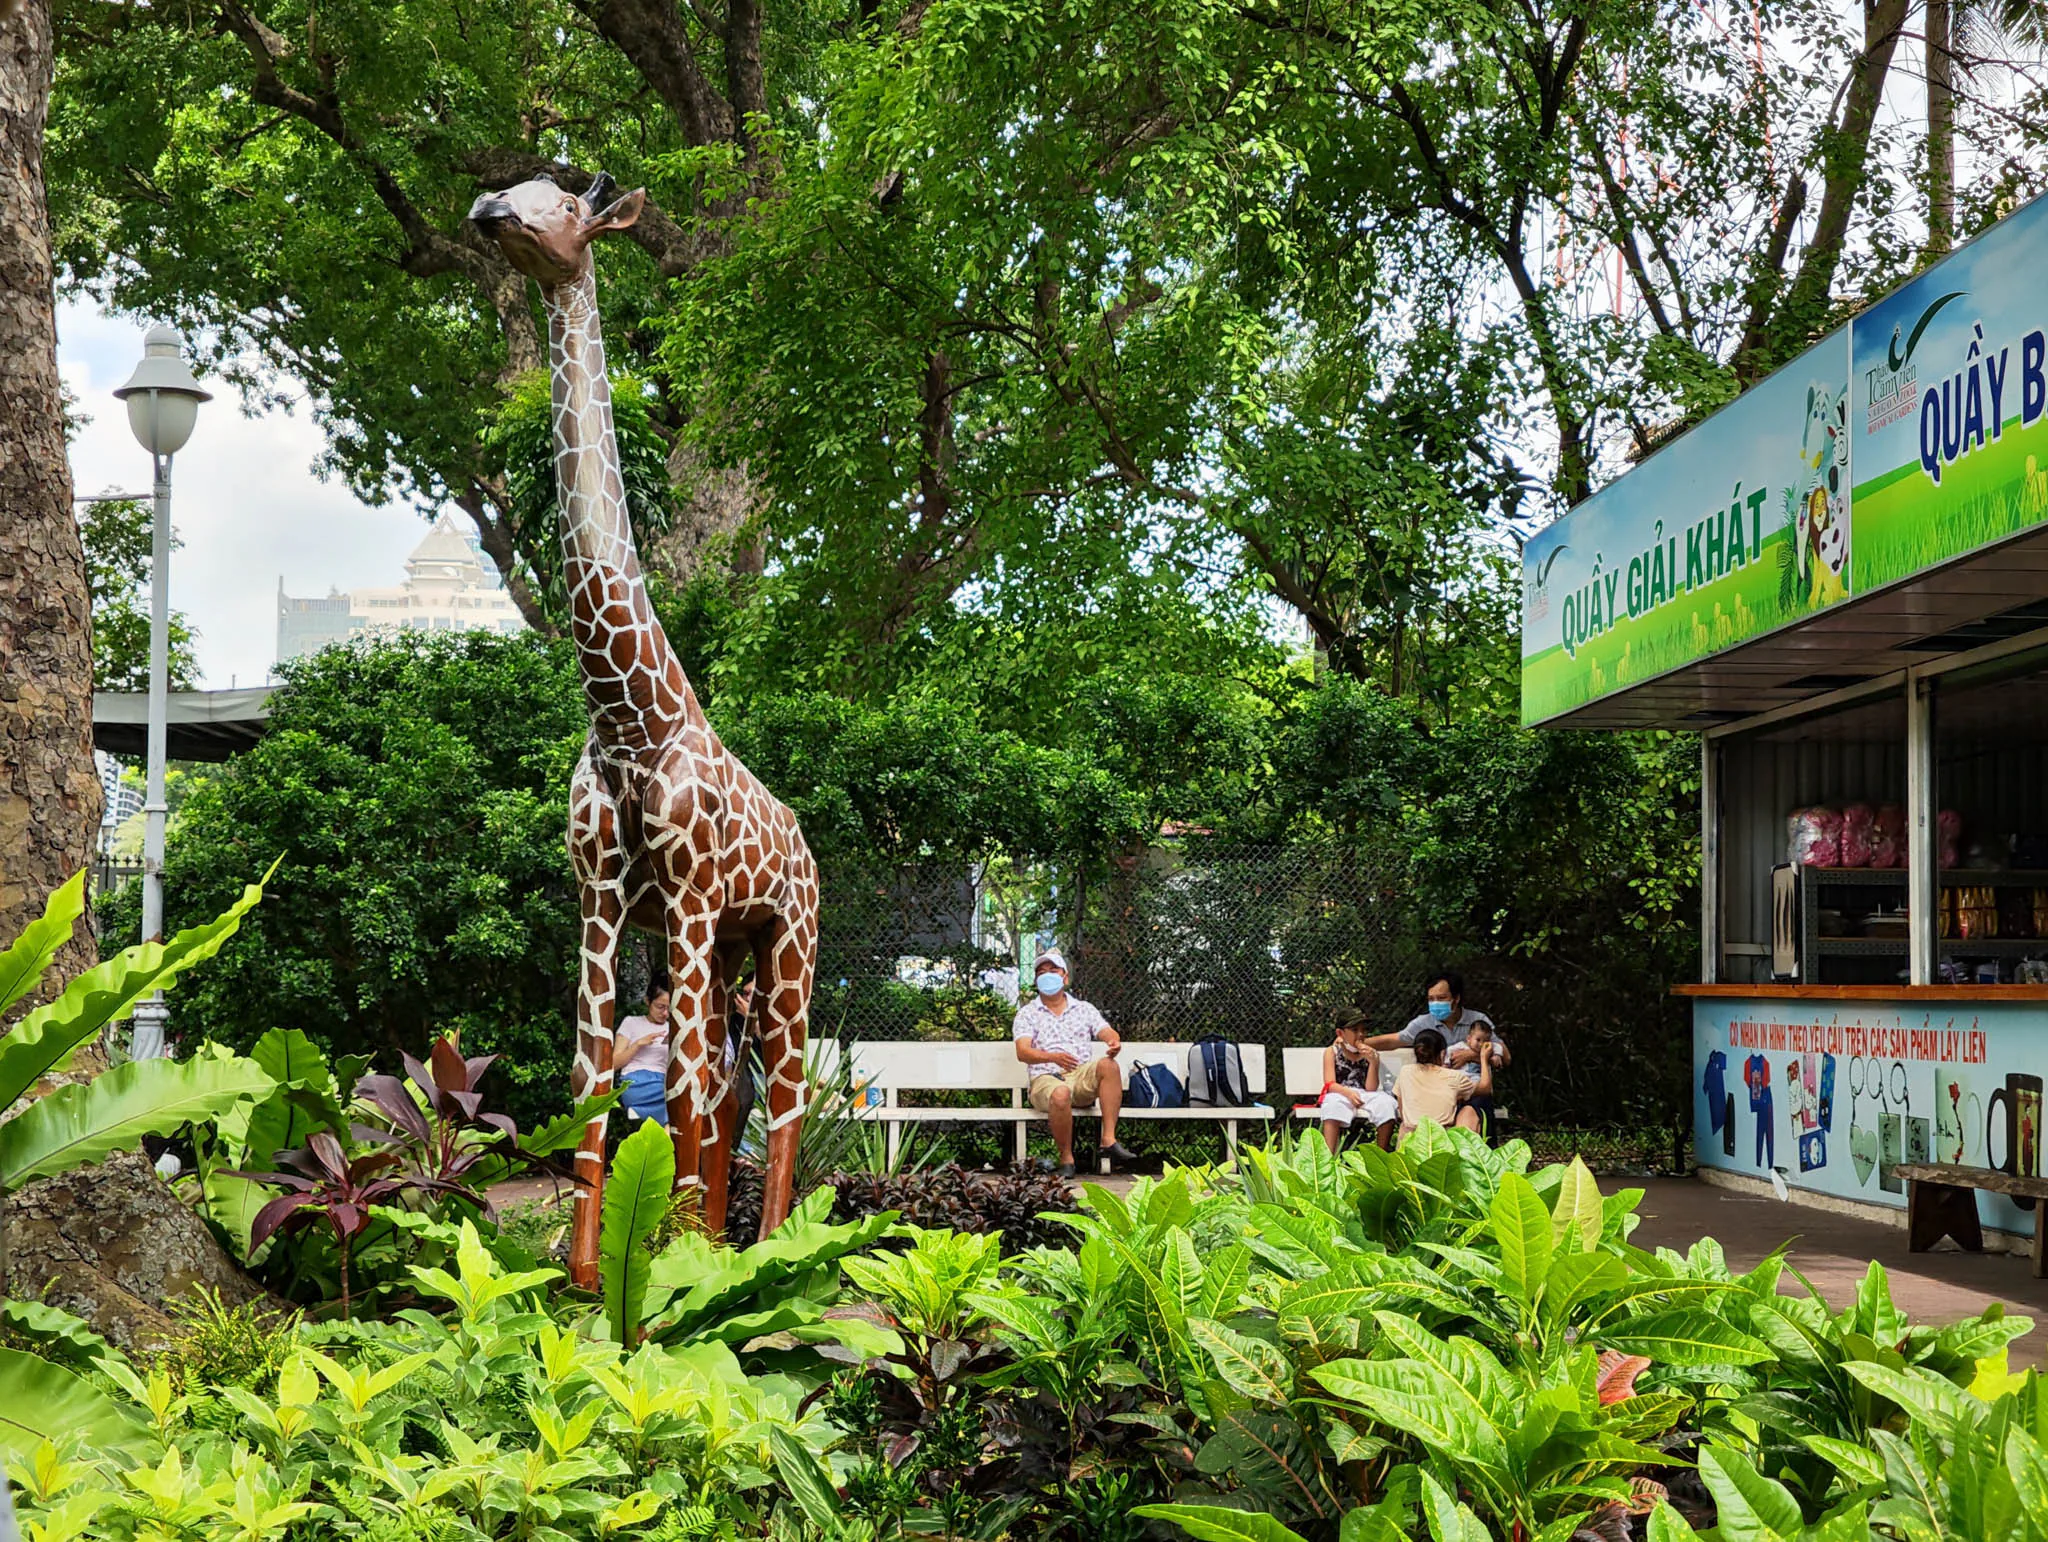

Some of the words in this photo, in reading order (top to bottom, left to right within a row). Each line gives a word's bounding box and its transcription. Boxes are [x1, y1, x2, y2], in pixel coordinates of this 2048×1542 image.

[1920, 323, 2009, 482] QUẦY
[2022, 330, 2048, 425] B
[1562, 552, 1619, 657] QUẦY
[1627, 519, 1675, 619] GIẢI
[1686, 480, 1767, 592] KHÁT
[1760, 1023, 1768, 1050] IN
[1769, 1016, 1786, 1052] HÌNH
[1788, 1024, 1808, 1053] THEO
[1809, 1017, 1825, 1054] YÊU
[1827, 1012, 1843, 1056] CẦU
[1845, 1018, 1868, 1057] TRÊN
[1870, 1018, 1888, 1058] CÁC
[1889, 1015, 1908, 1060] SẢN
[1910, 1011, 1938, 1061] PHẨM
[1940, 1016, 1960, 1064] LẤY
[1962, 1015, 1986, 1065] LIỀN
